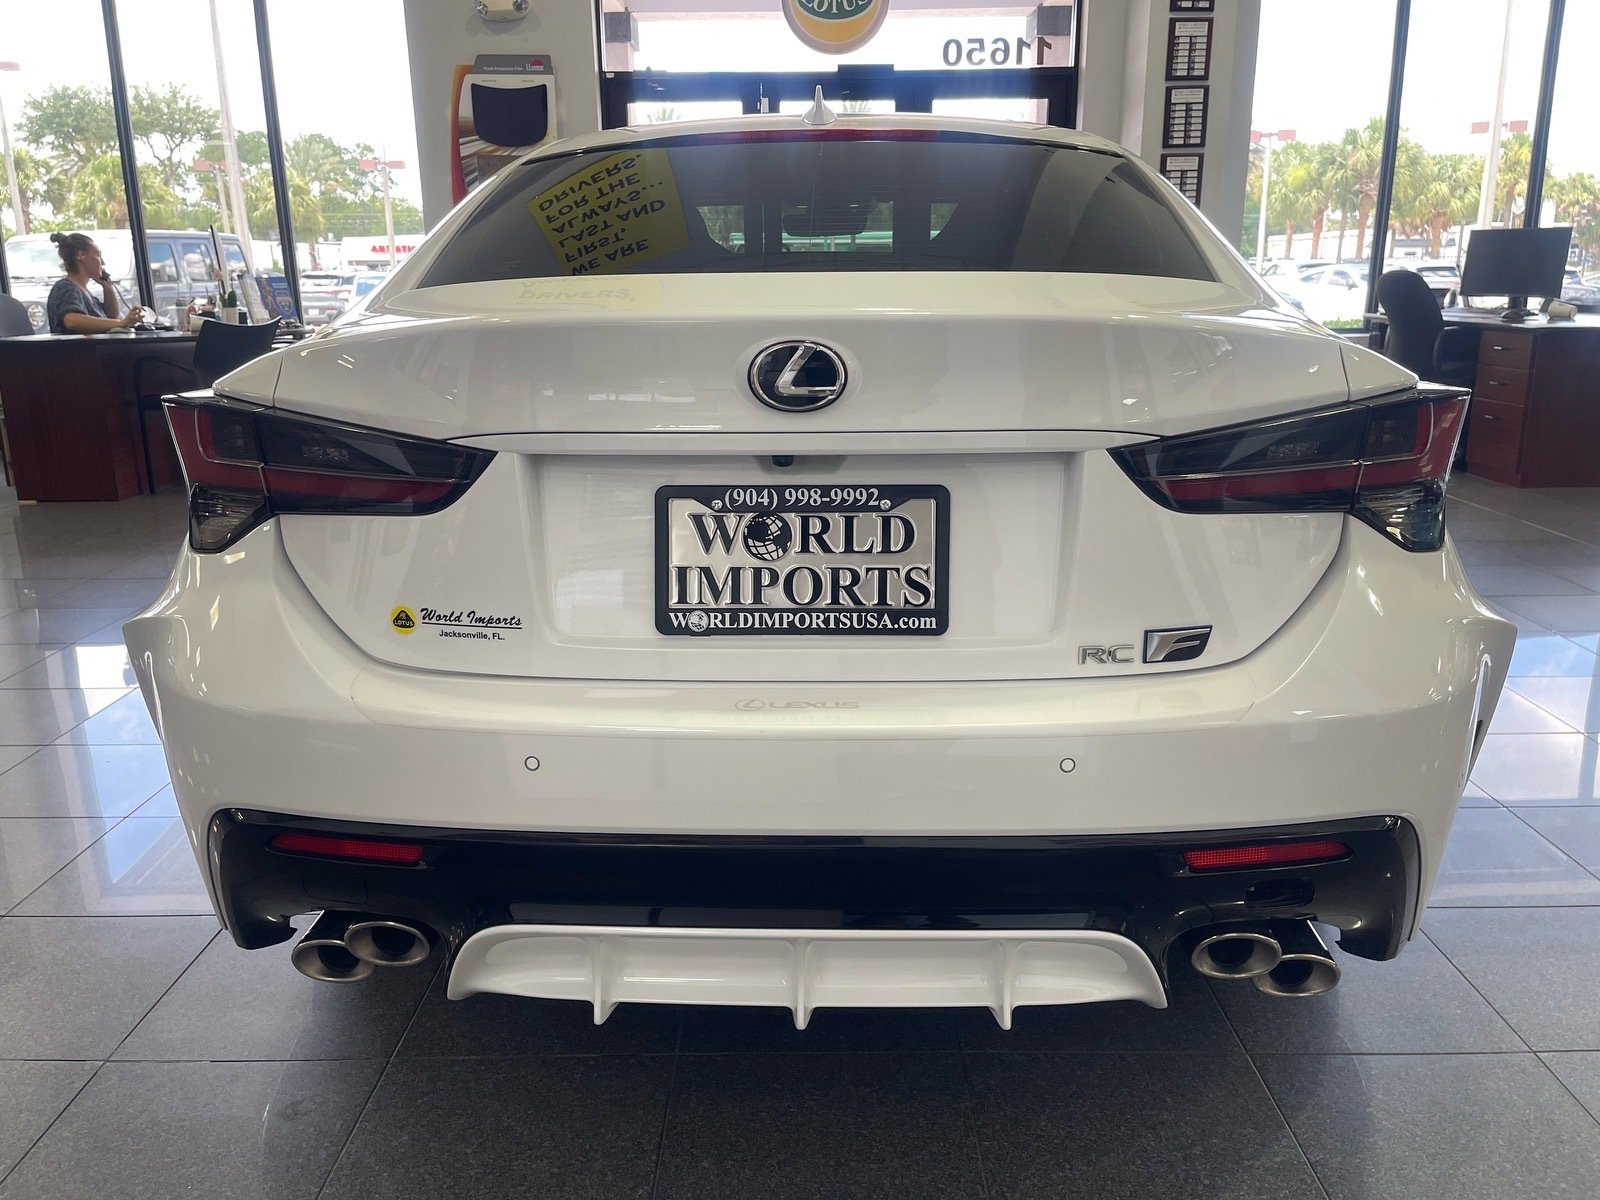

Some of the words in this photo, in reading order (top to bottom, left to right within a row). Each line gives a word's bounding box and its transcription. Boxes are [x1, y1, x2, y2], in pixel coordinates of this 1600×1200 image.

[724, 487, 778, 510] (904)
[784, 487, 879, 508] 998-9992
[671, 565, 934, 608] IMPORTS
[420, 607, 464, 623] World
[466, 611, 523, 627] Imports
[669, 610, 937, 632] WORLDIMPORTSUSA.com
[438, 630, 490, 641] Jacksonville,
[492, 632, 506, 641] FL.
[1078, 644, 1135, 665] RC
[768, 701, 860, 709] LEXUS
